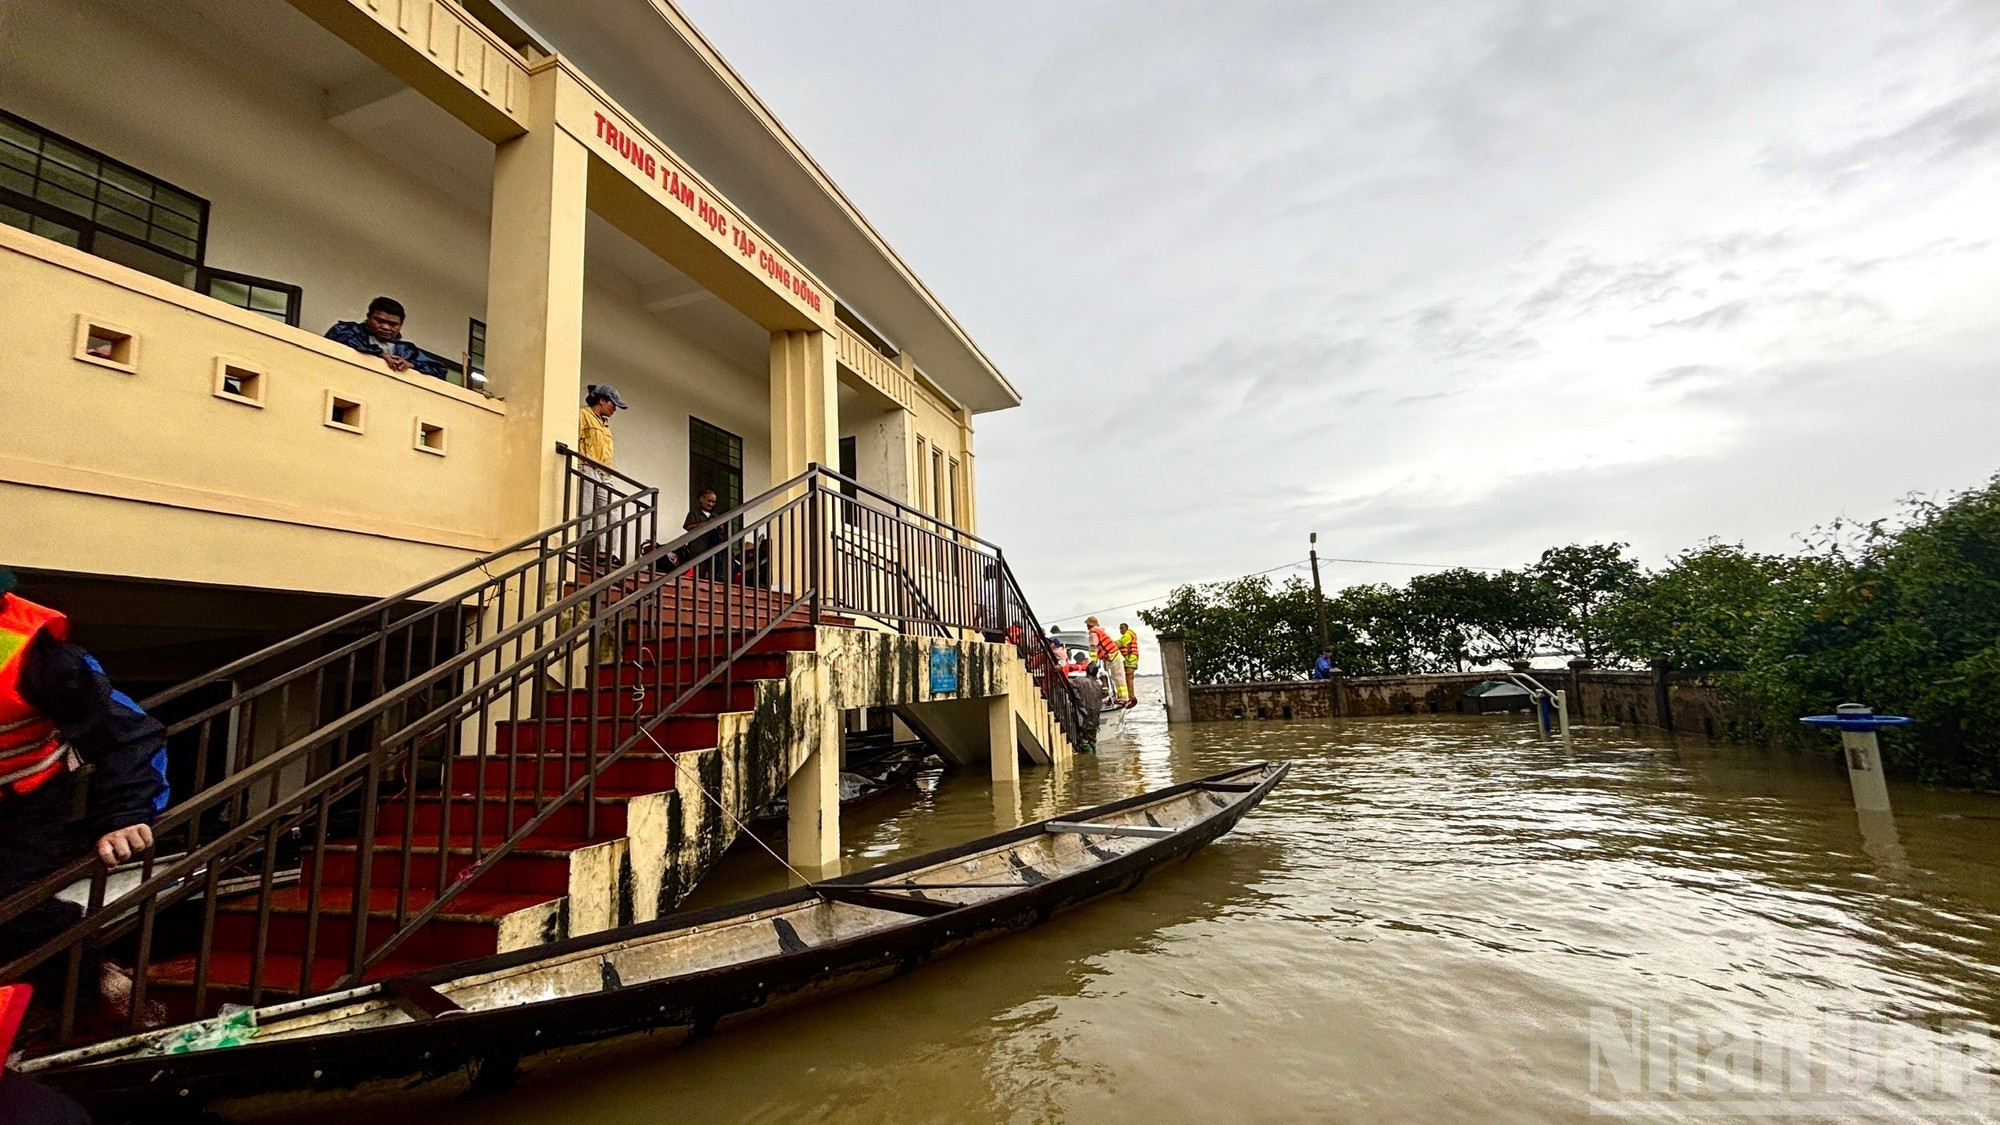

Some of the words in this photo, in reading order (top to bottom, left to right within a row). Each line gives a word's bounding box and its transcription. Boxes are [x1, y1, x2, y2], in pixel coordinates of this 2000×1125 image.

[594, 112, 656, 180] TRUNG
[661, 166, 694, 210] TÂM
[699, 197, 727, 236] HỌC
[732, 226, 756, 259] TẬP
[759, 249, 790, 289] CỘNG
